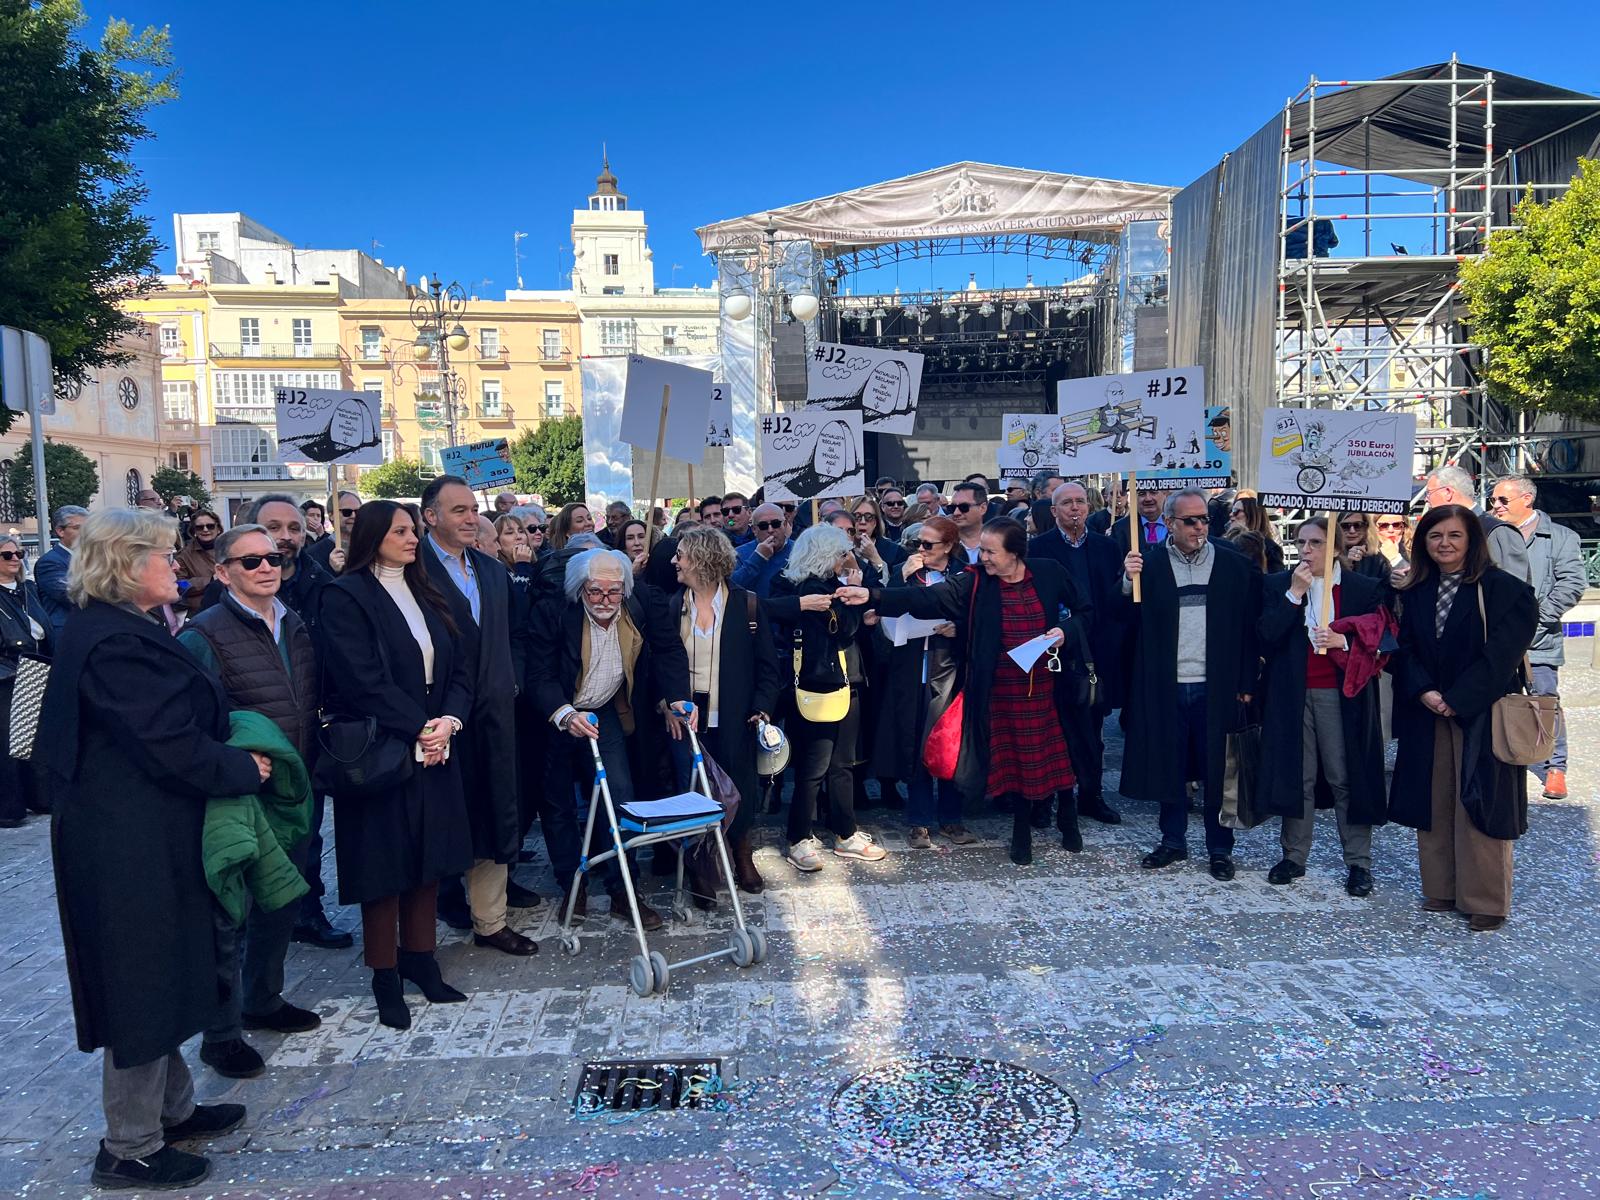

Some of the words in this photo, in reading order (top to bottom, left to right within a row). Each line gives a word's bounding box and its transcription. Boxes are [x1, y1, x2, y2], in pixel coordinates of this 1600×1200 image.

[944, 219, 1033, 233] CARNAVALERA
[1036, 213, 1084, 228] CIUDAD
[1086, 214, 1104, 225] DE
[815, 346, 846, 364] #J2
[1147, 376, 1187, 398] #J2
[277, 389, 308, 406] #J2
[762, 416, 793, 434] #J2
[1277, 418, 1295, 431] #J2
[469, 441, 495, 453] MUTUA
[1347, 439, 1367, 448] 350
[1369, 440, 1394, 450] Euros
[446, 451, 462, 461] #J2
[1347, 449, 1395, 459] JUBILACIÓN
[489, 468, 509, 477] 350
[1003, 469, 1028, 478] ABOGADO,
[1158, 479, 1186, 489] DEFIENDE
[1198, 477, 1227, 488] DERECHOS
[1262, 494, 1305, 509] ABOGADO,
[1306, 497, 1346, 510] DEFIENDE
[1347, 500, 1361, 511] TUS
[1361, 501, 1404, 514] DERECHOS
